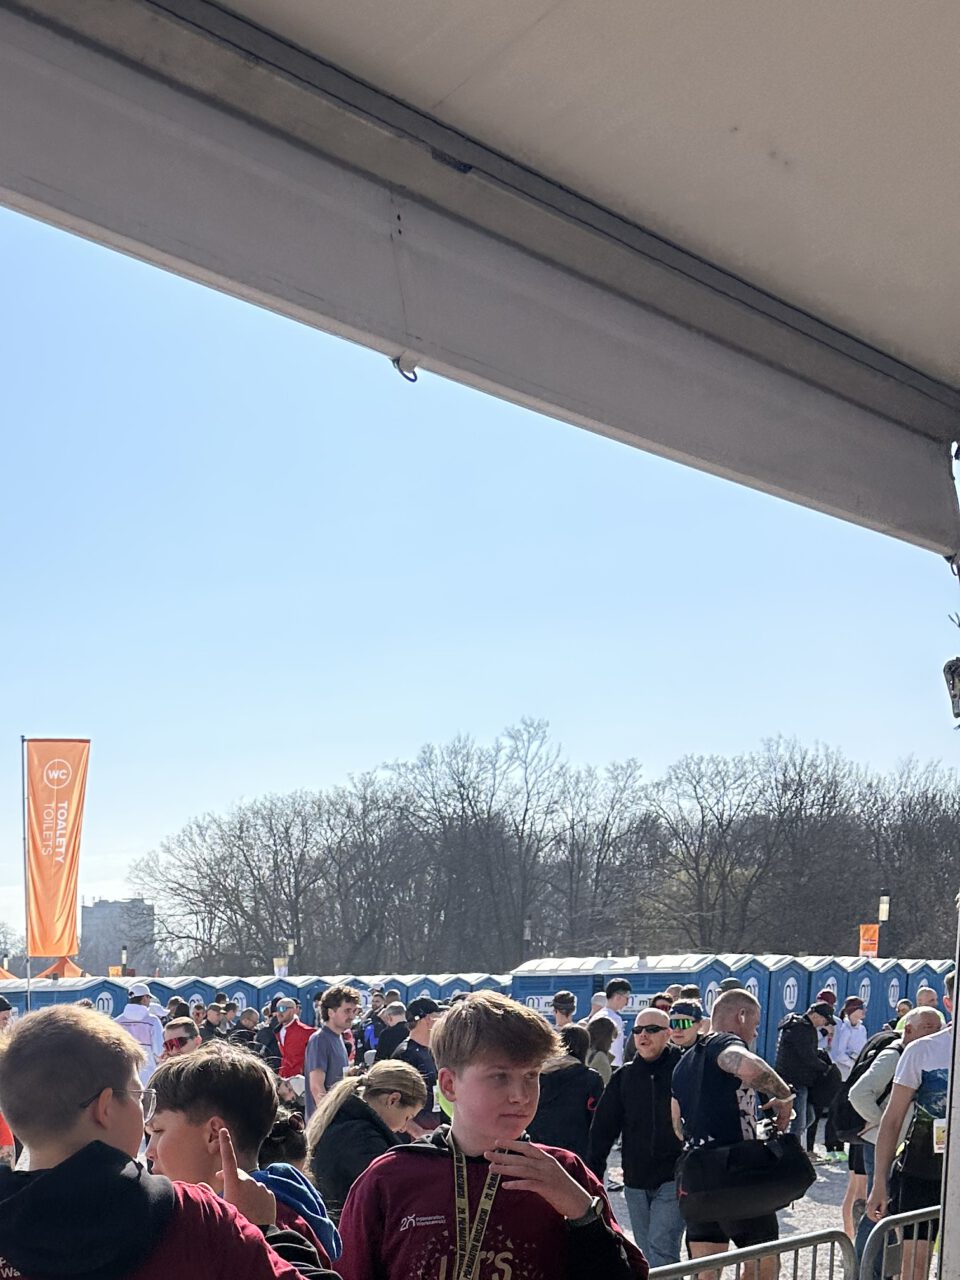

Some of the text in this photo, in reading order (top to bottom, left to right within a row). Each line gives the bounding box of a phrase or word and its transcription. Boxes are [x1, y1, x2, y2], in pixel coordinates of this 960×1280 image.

[48, 770, 68, 779] WC
[42, 802, 55, 856] TOILETS
[54, 801, 68, 863] TOALETY
